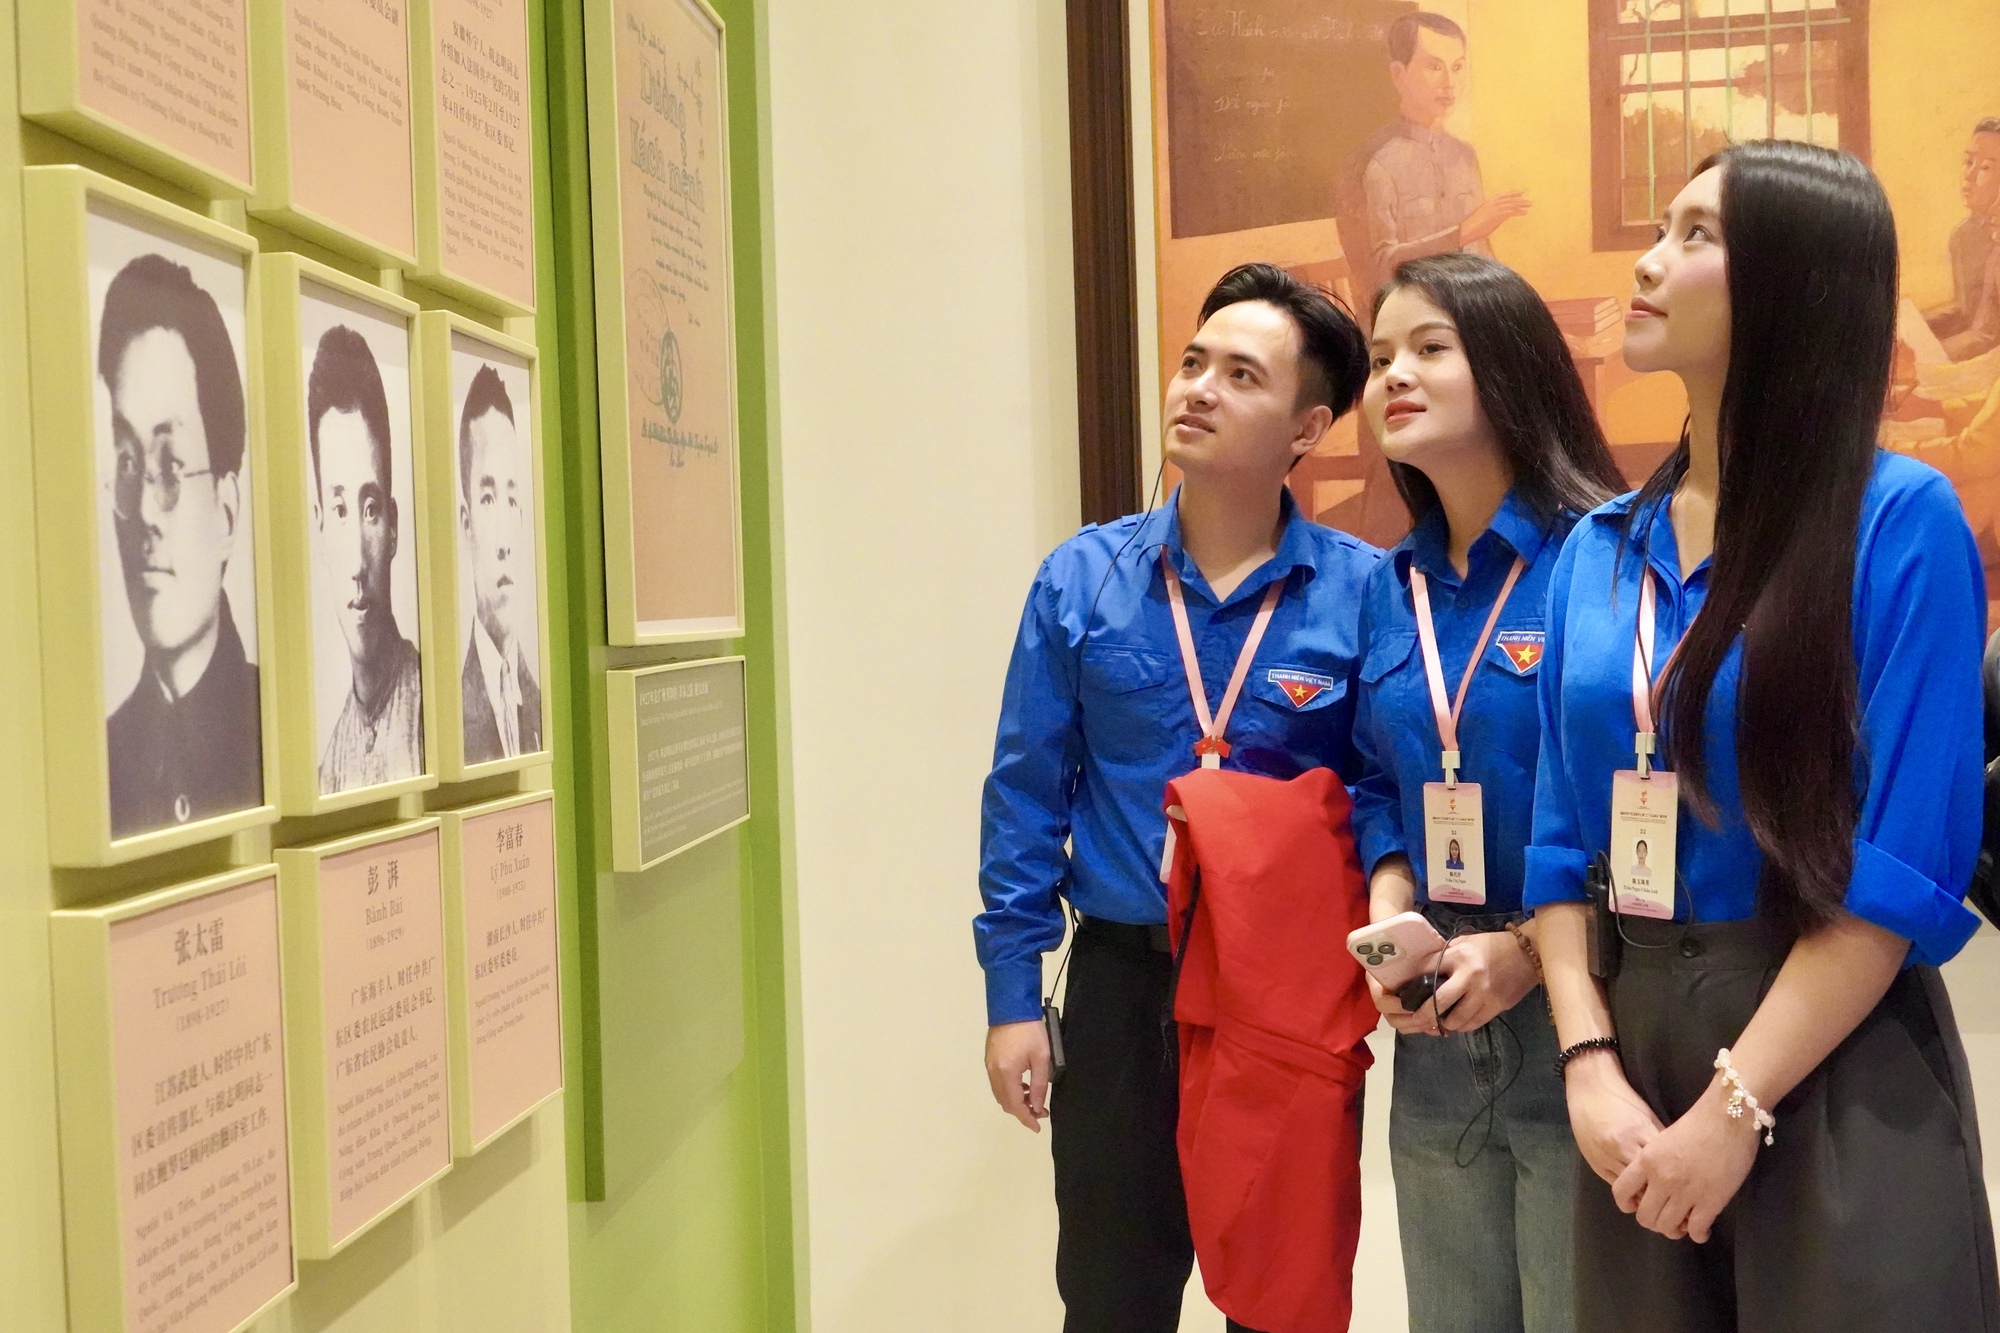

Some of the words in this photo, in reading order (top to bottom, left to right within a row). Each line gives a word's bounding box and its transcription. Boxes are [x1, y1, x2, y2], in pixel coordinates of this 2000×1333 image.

[496, 823, 522, 853] 李富春
[174, 917, 223, 964] 张太雷
